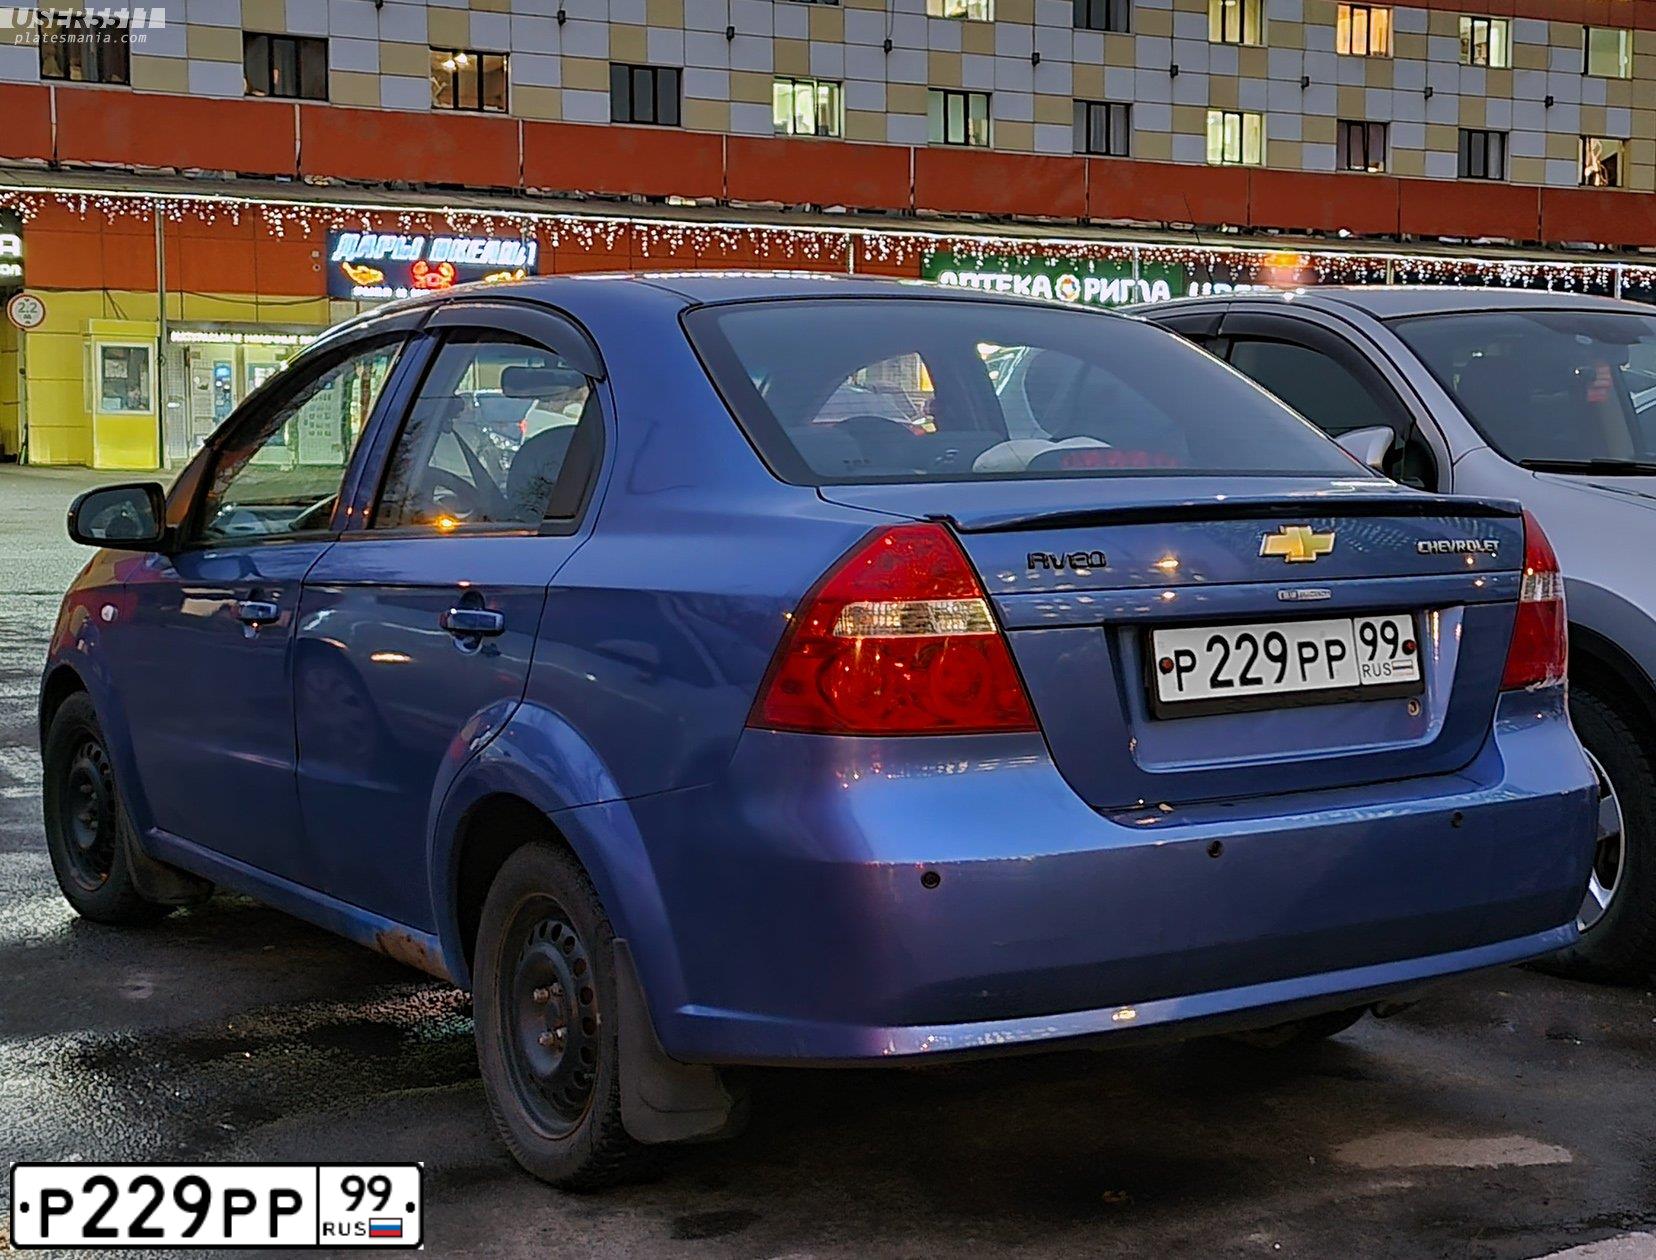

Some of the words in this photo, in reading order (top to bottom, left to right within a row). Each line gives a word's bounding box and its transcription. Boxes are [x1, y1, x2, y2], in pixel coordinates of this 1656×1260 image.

[331, 232, 426, 261] ДАРЫ
[939, 271, 1053, 299] АПТЕКА
[1084, 277, 1171, 303] РИГЛА
[1417, 539, 1500, 554] CHEVROLET
[1358, 619, 1400, 661] 99
[1361, 661, 1392, 678] RUS
